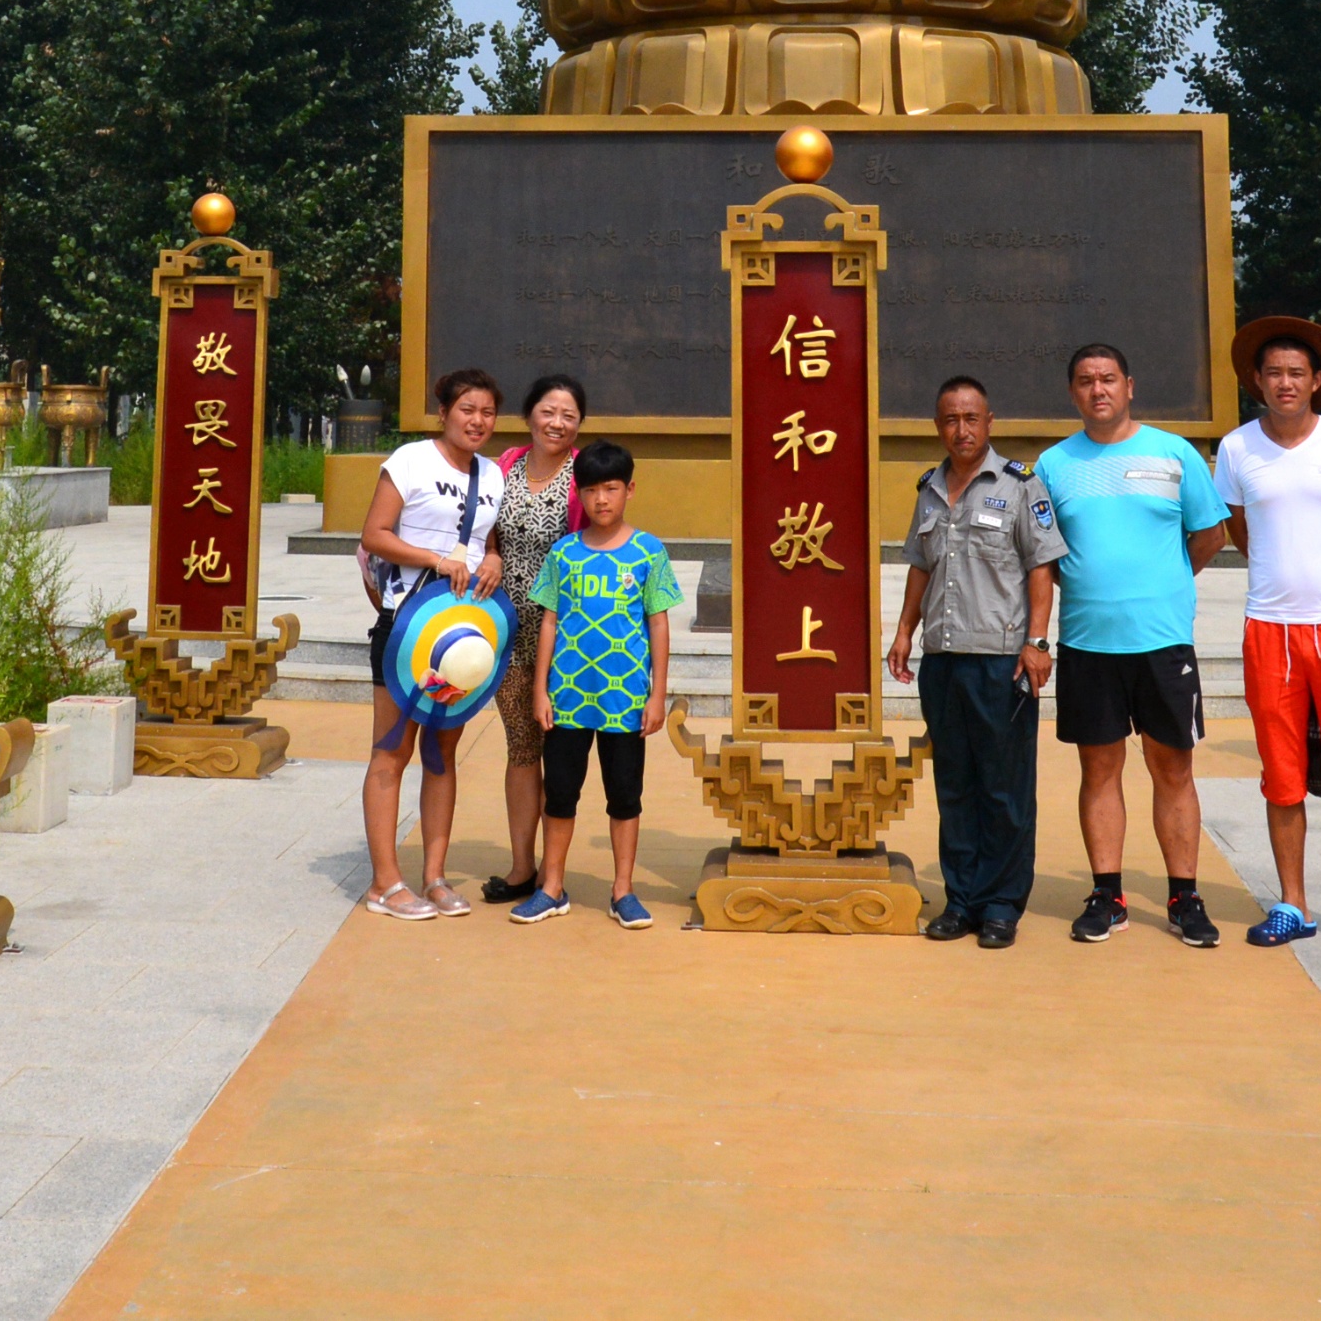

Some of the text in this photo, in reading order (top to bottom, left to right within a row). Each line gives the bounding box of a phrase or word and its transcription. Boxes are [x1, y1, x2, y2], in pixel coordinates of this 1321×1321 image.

[183, 332, 237, 583] 敬畏天地
[770, 314, 845, 664] 信和敬上
